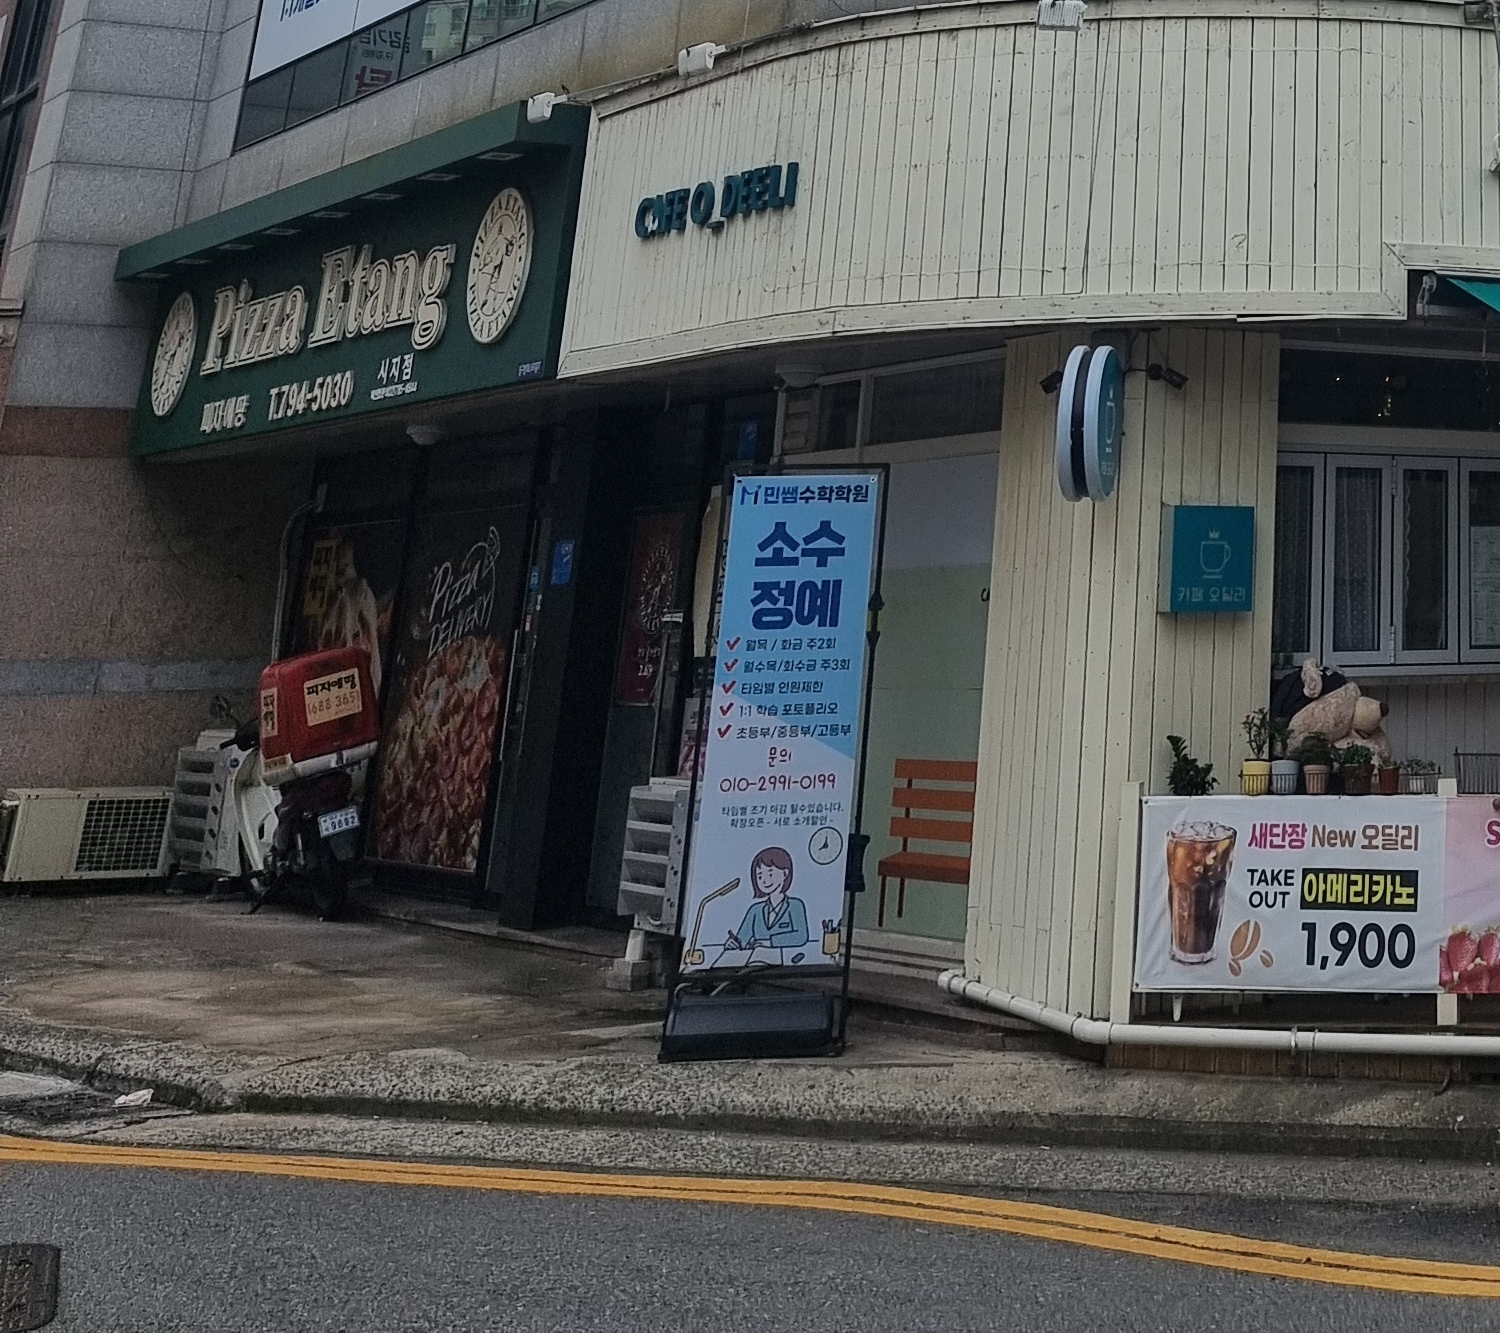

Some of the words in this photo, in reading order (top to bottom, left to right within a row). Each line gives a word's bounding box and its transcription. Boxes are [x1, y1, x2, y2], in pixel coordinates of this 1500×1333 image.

[200, 279, 308, 375] Pizza
[308, 243, 456, 351] Etang
[377, 353, 414, 384] 시지점
[268, 370, 354, 420] T.794-5030
[754, 520, 846, 568] 소수
[750, 579, 843, 630] 정예
[807, 637, 837, 650] 주2회
[820, 658, 851, 671] 주3회
[768, 746, 792, 767] 문의
[719, 773, 836, 792] 010-2991-0199
[1248, 822, 1307, 850] 새단장
[1312, 825, 1356, 848] New
[1361, 824, 1419, 851] 오딜리
[1247, 869, 1295, 887] TAKE
[1303, 872, 1415, 906] 아메리카노
[1248, 891, 1290, 908] OUT
[1301, 922, 1415, 970] 1,900
